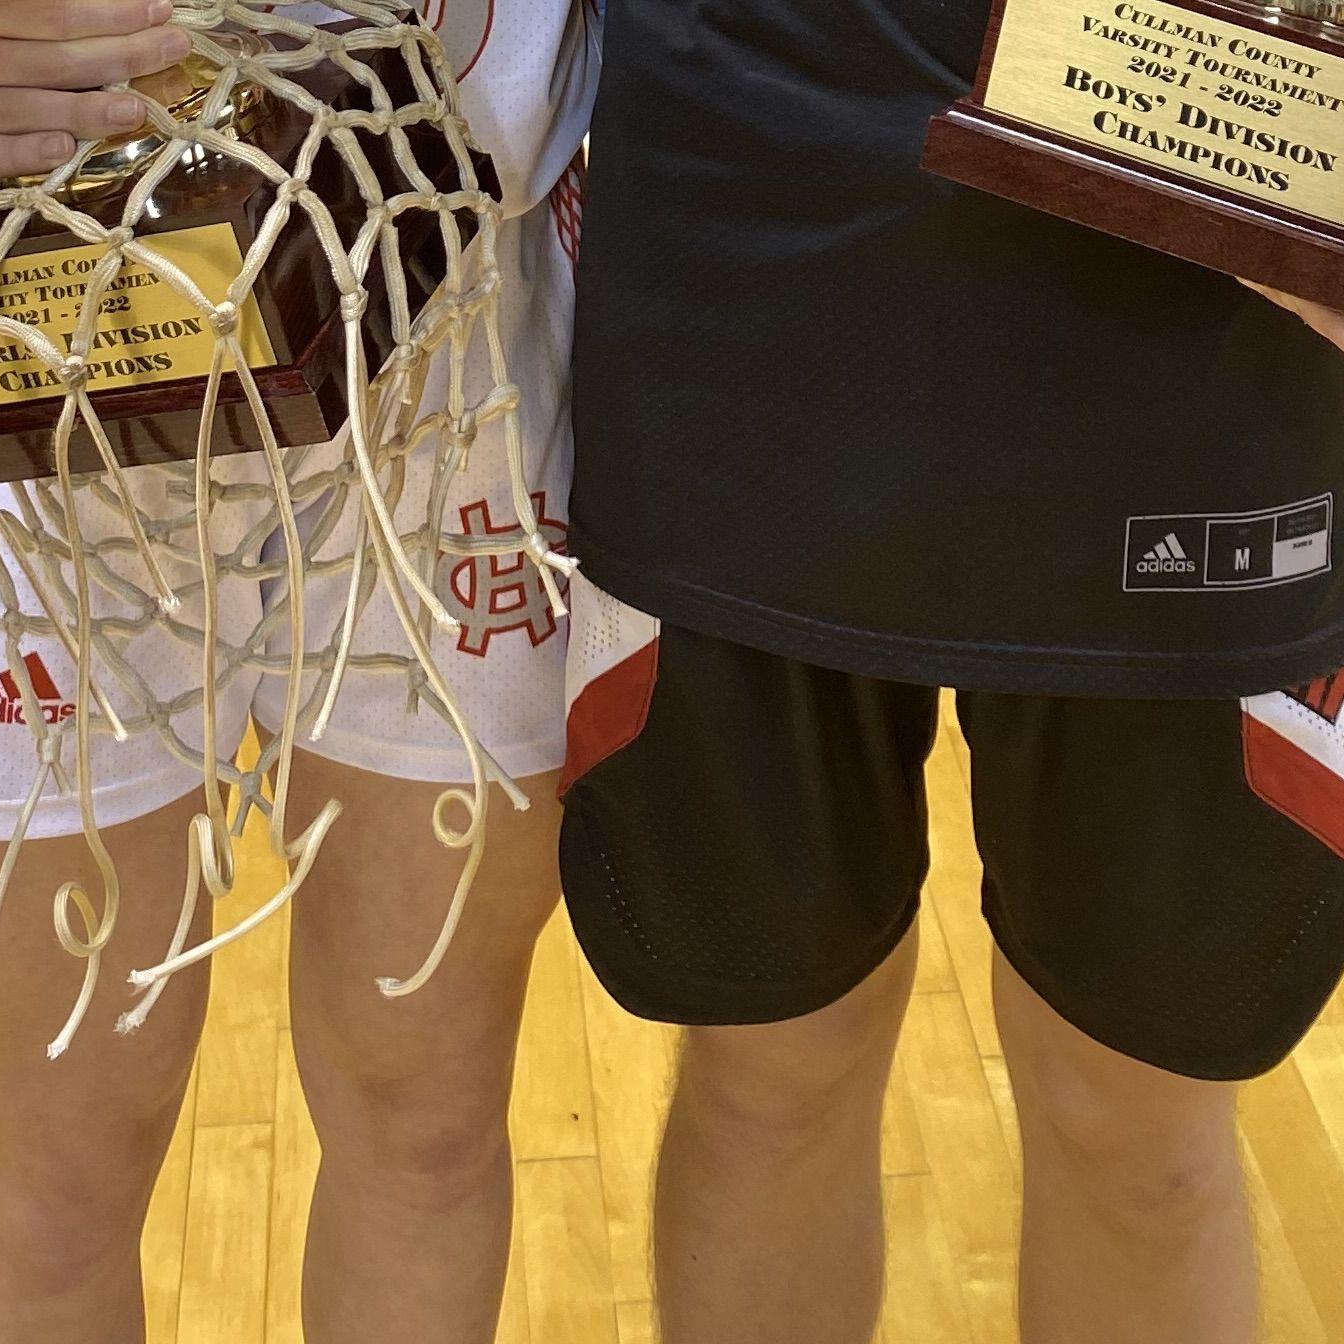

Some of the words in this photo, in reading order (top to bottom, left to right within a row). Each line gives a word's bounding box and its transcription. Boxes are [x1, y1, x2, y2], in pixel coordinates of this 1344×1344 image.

[1081, 14, 1181, 60] VARSITY
[1114, 2, 1224, 49] CULLMAN
[1228, 37, 1323, 80] COUNTY
[1126, 55, 1194, 90] 2021
[1214, 83, 1285, 118] 2022
[1092, 110, 1291, 193] CHAMPIONS
[1175, 101, 1339, 173] DIVISION
[1, 307, 51, 326] 021
[74, 295, 132, 319] 22
[34, 271, 161, 303] TOURAMEN
[1136, 557, 1196, 573] adidas
[1234, 546, 1251, 572] M
